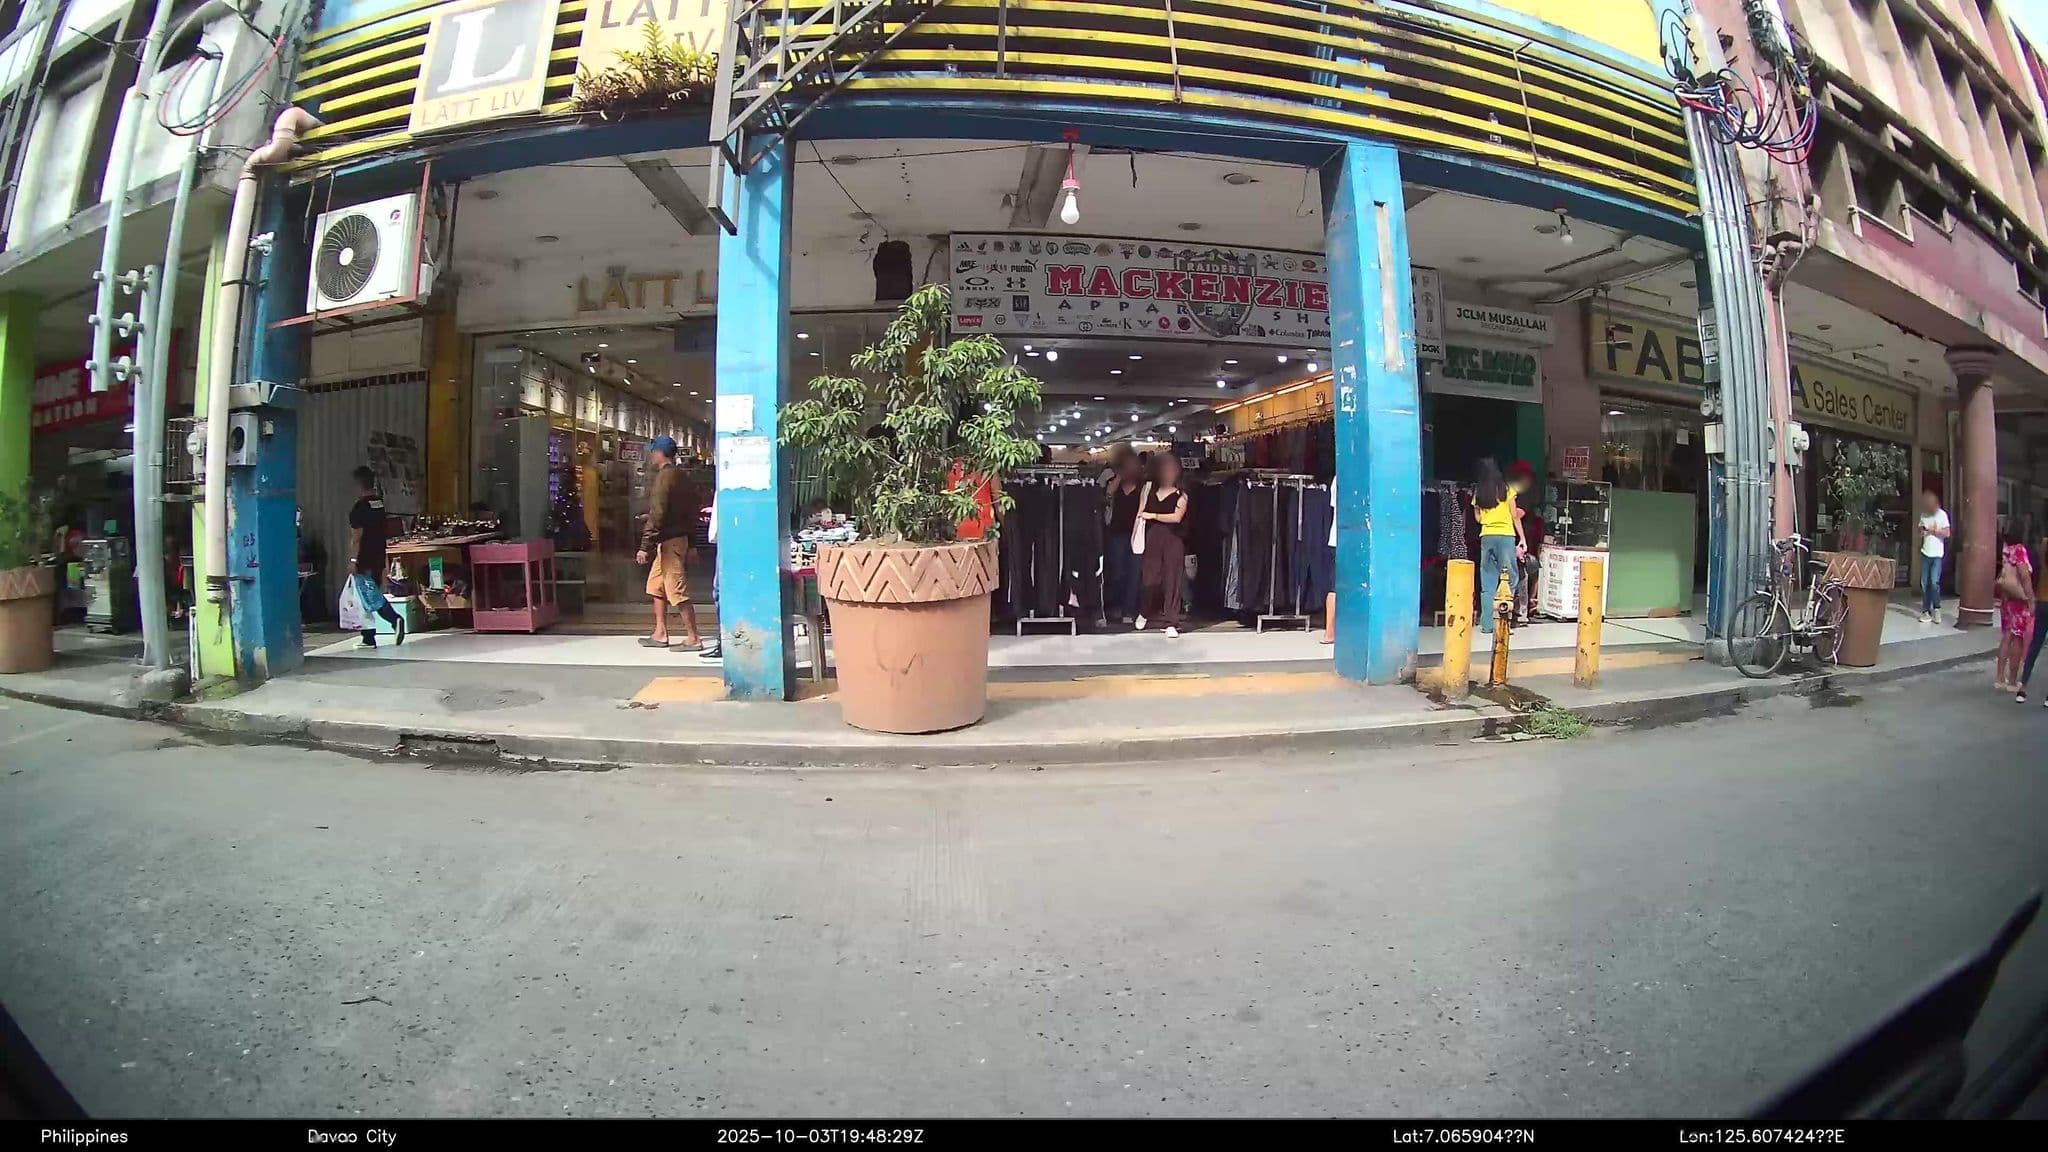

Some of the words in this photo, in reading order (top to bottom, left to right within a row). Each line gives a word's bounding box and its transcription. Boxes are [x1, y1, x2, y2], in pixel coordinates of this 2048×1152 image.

[491, 90, 524, 111] LIV
[1488, 312, 1547, 332] MUSALLAH
[1605, 322, 1702, 385] FAB
[1813, 381, 1857, 420] Sales
[1863, 394, 1908, 433] Center
